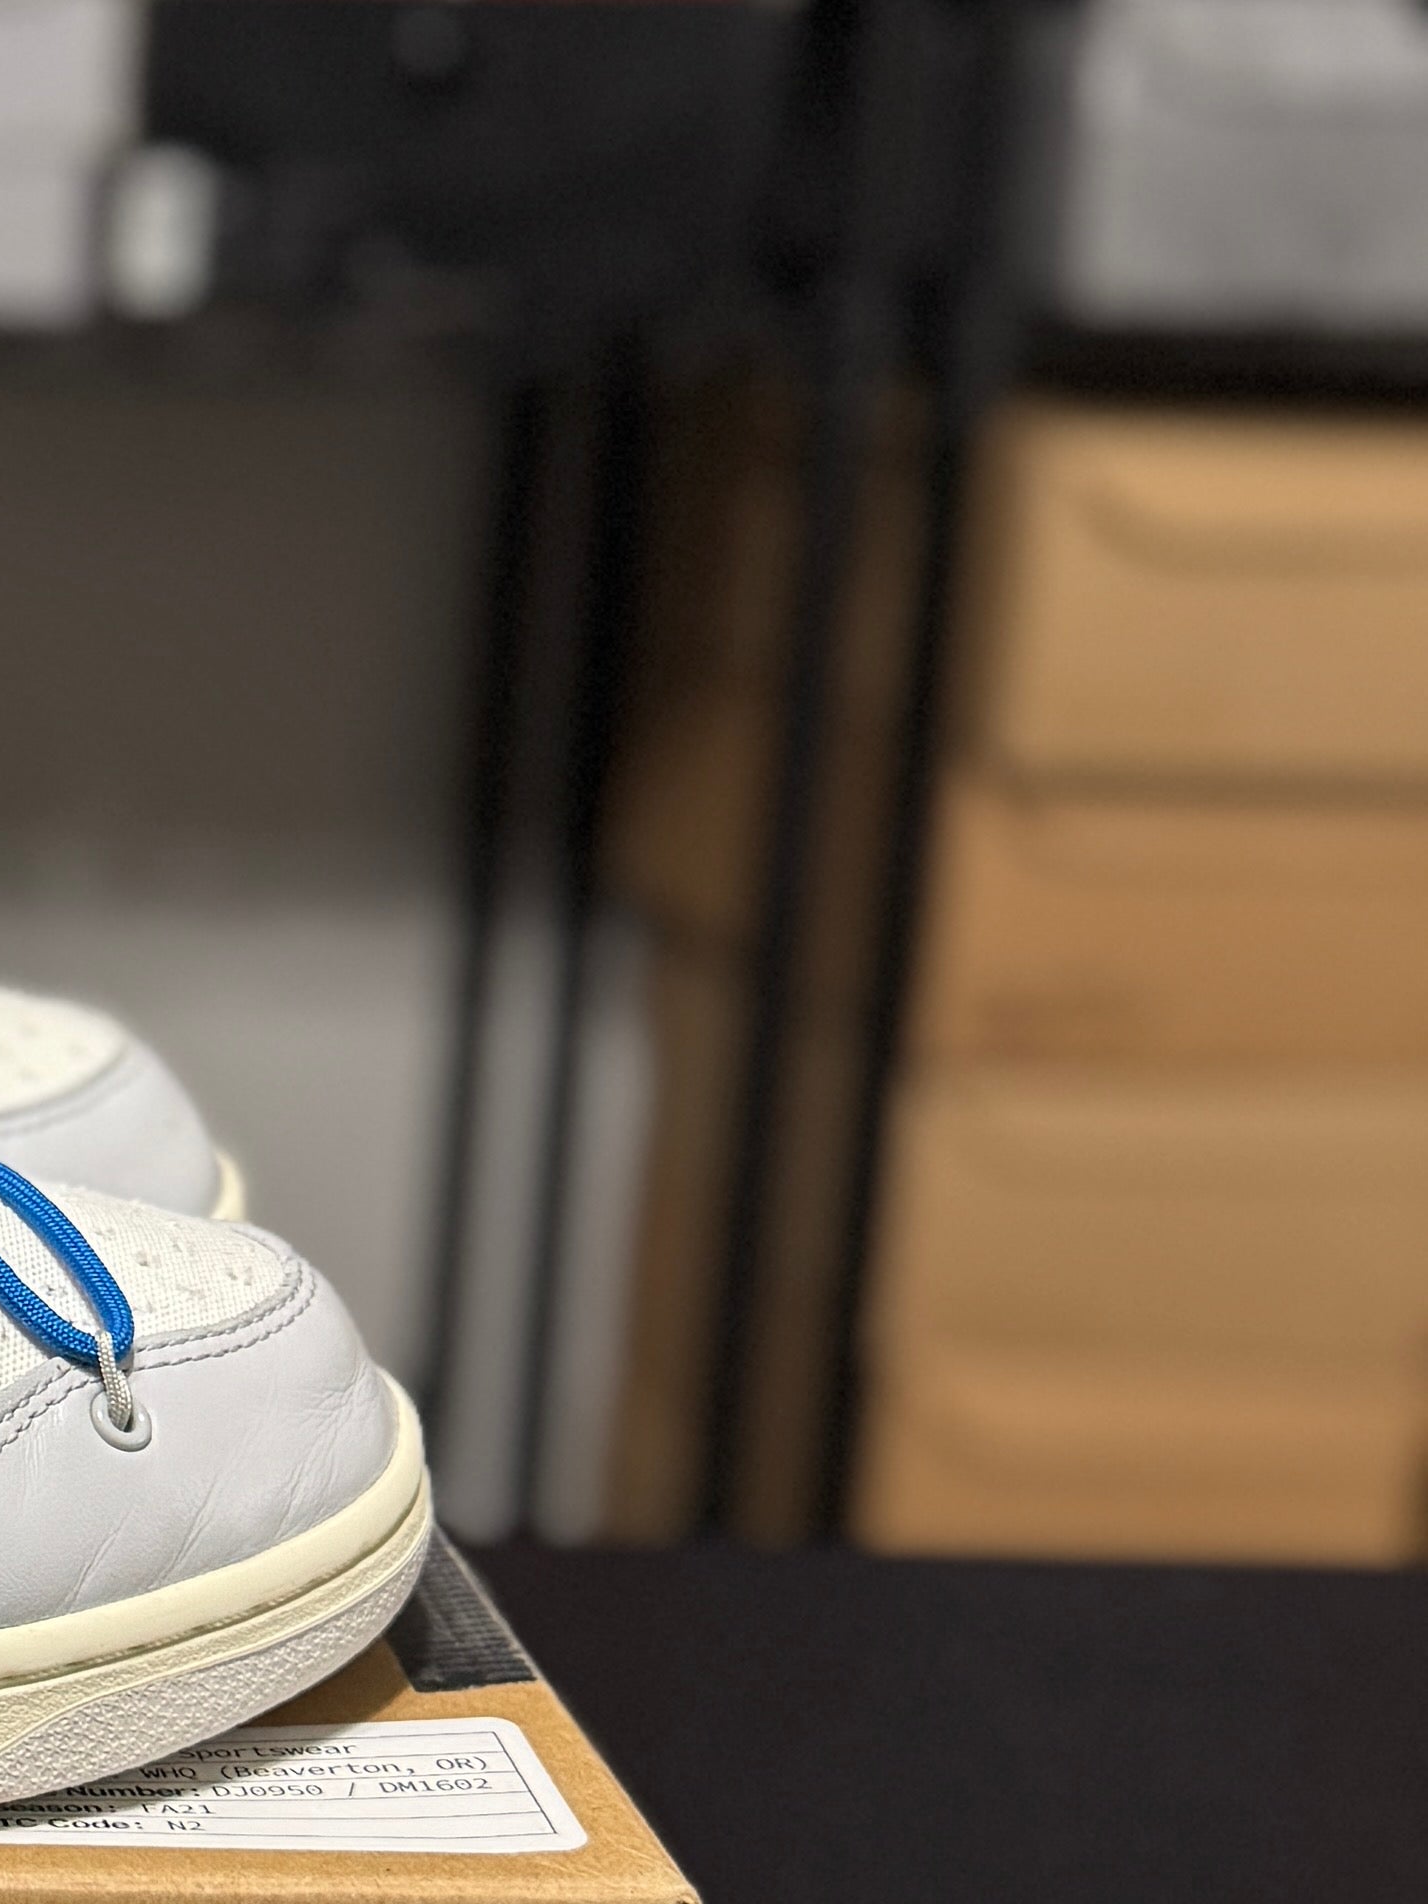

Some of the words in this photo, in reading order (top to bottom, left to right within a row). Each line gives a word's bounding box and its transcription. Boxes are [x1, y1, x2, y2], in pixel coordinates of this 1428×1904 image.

[177, 1742, 358, 1762] Sportswear
[139, 1766, 198, 1781] WHQ
[221, 1760, 415, 1780] (Beaverton,
[435, 1756, 489, 1772] OR)
[66, 1785, 201, 1798] Number:
[212, 1783, 323, 1799] DJ0950
[378, 1777, 493, 1794] DM1602
[47, 1817, 145, 1829] Code:
[166, 1819, 207, 1832] N2
